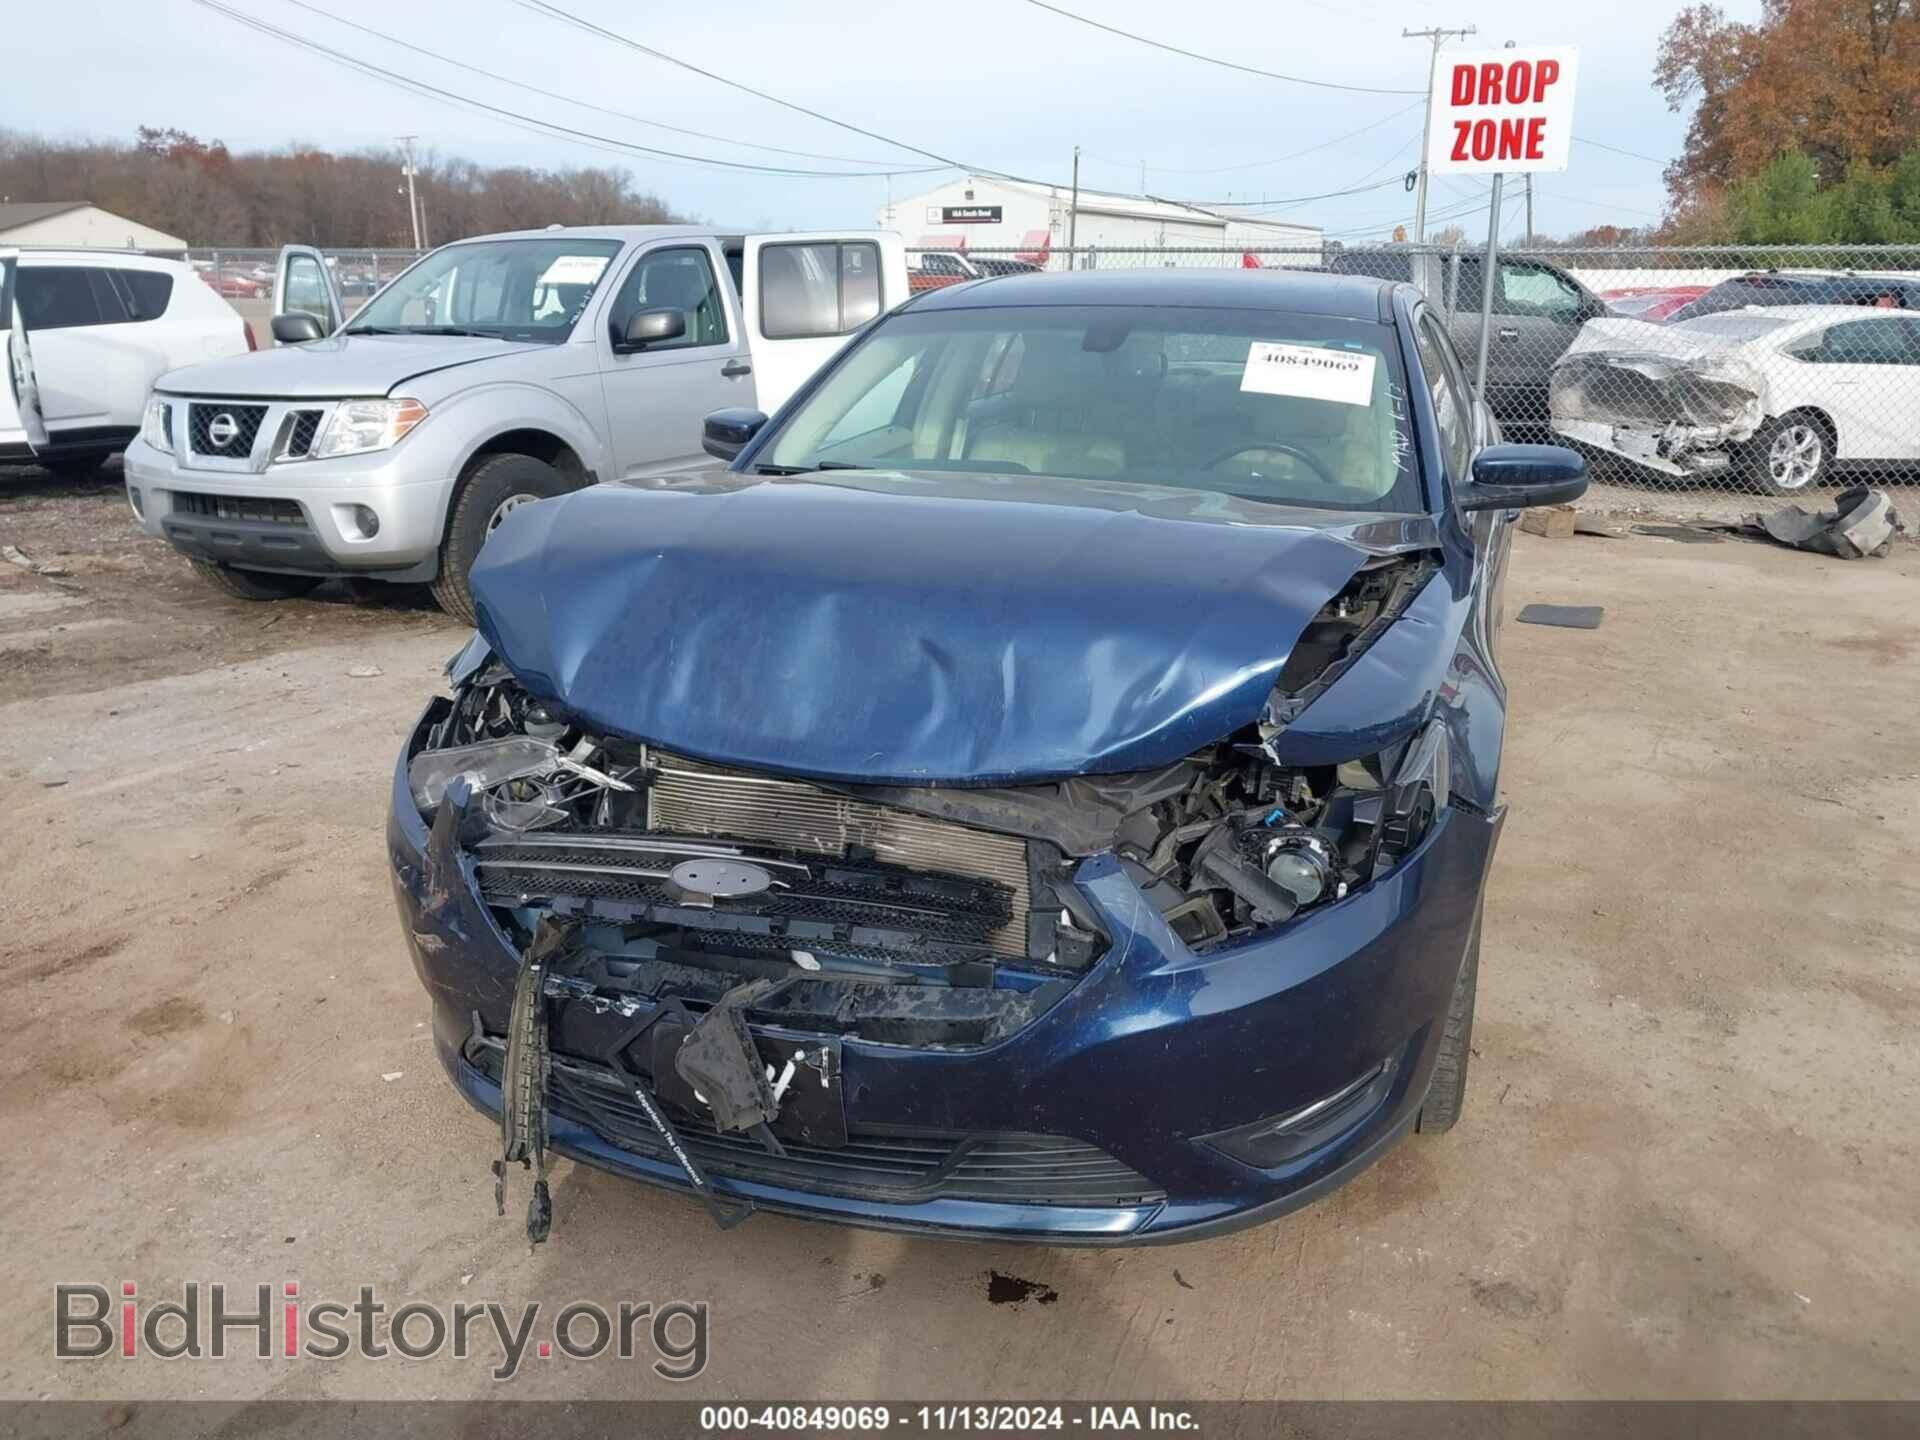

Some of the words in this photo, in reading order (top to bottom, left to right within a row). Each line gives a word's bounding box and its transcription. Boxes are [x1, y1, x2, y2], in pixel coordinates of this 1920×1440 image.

[1451, 60, 1559, 106] DROP
[1450, 117, 1547, 161] ZONE
[1261, 353, 1360, 372] 40849069
[664, 1131, 676, 1146] The
